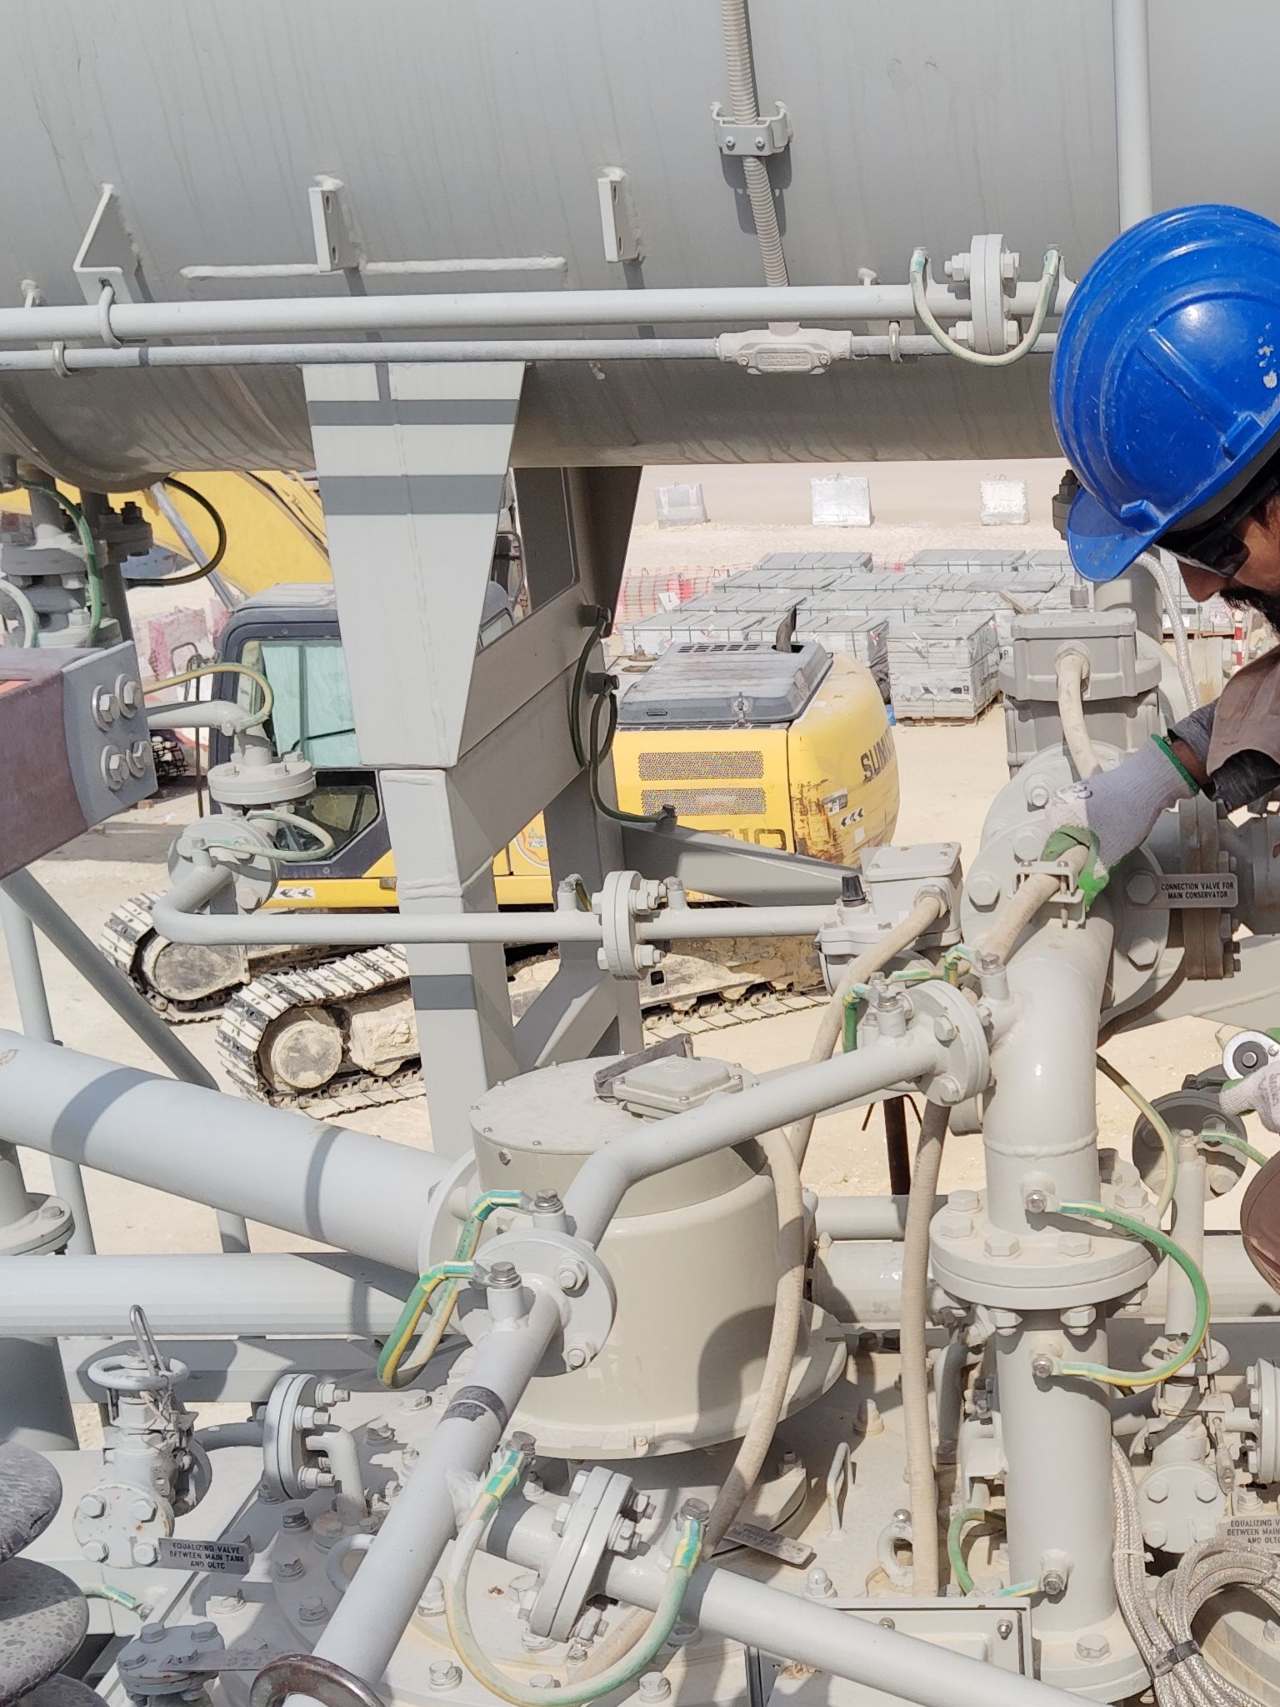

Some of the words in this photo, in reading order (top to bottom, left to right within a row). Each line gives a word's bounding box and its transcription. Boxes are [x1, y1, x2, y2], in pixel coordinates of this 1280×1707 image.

[1160, 882, 1199, 891] CONNECTION
[1200, 881, 1221, 890] VALVE
[1222, 881, 1234, 890] FOR
[1167, 891, 1184, 900] MAIN
[1185, 890, 1229, 900] CONSERVATOR
[1230, 1519, 1273, 1528] EQUALIZING
[1226, 1528, 1260, 1537] BETWEEN
[1262, 1527, 1280, 1536] MAIN
[172, 1542, 215, 1552] EQUALIZING
[217, 1545, 241, 1554] VALVE
[169, 1550, 202, 1560] BETWEEN
[204, 1553, 223, 1561] MAIN
[226, 1554, 245, 1562] TANK
[190, 1560, 205, 1568] AND
